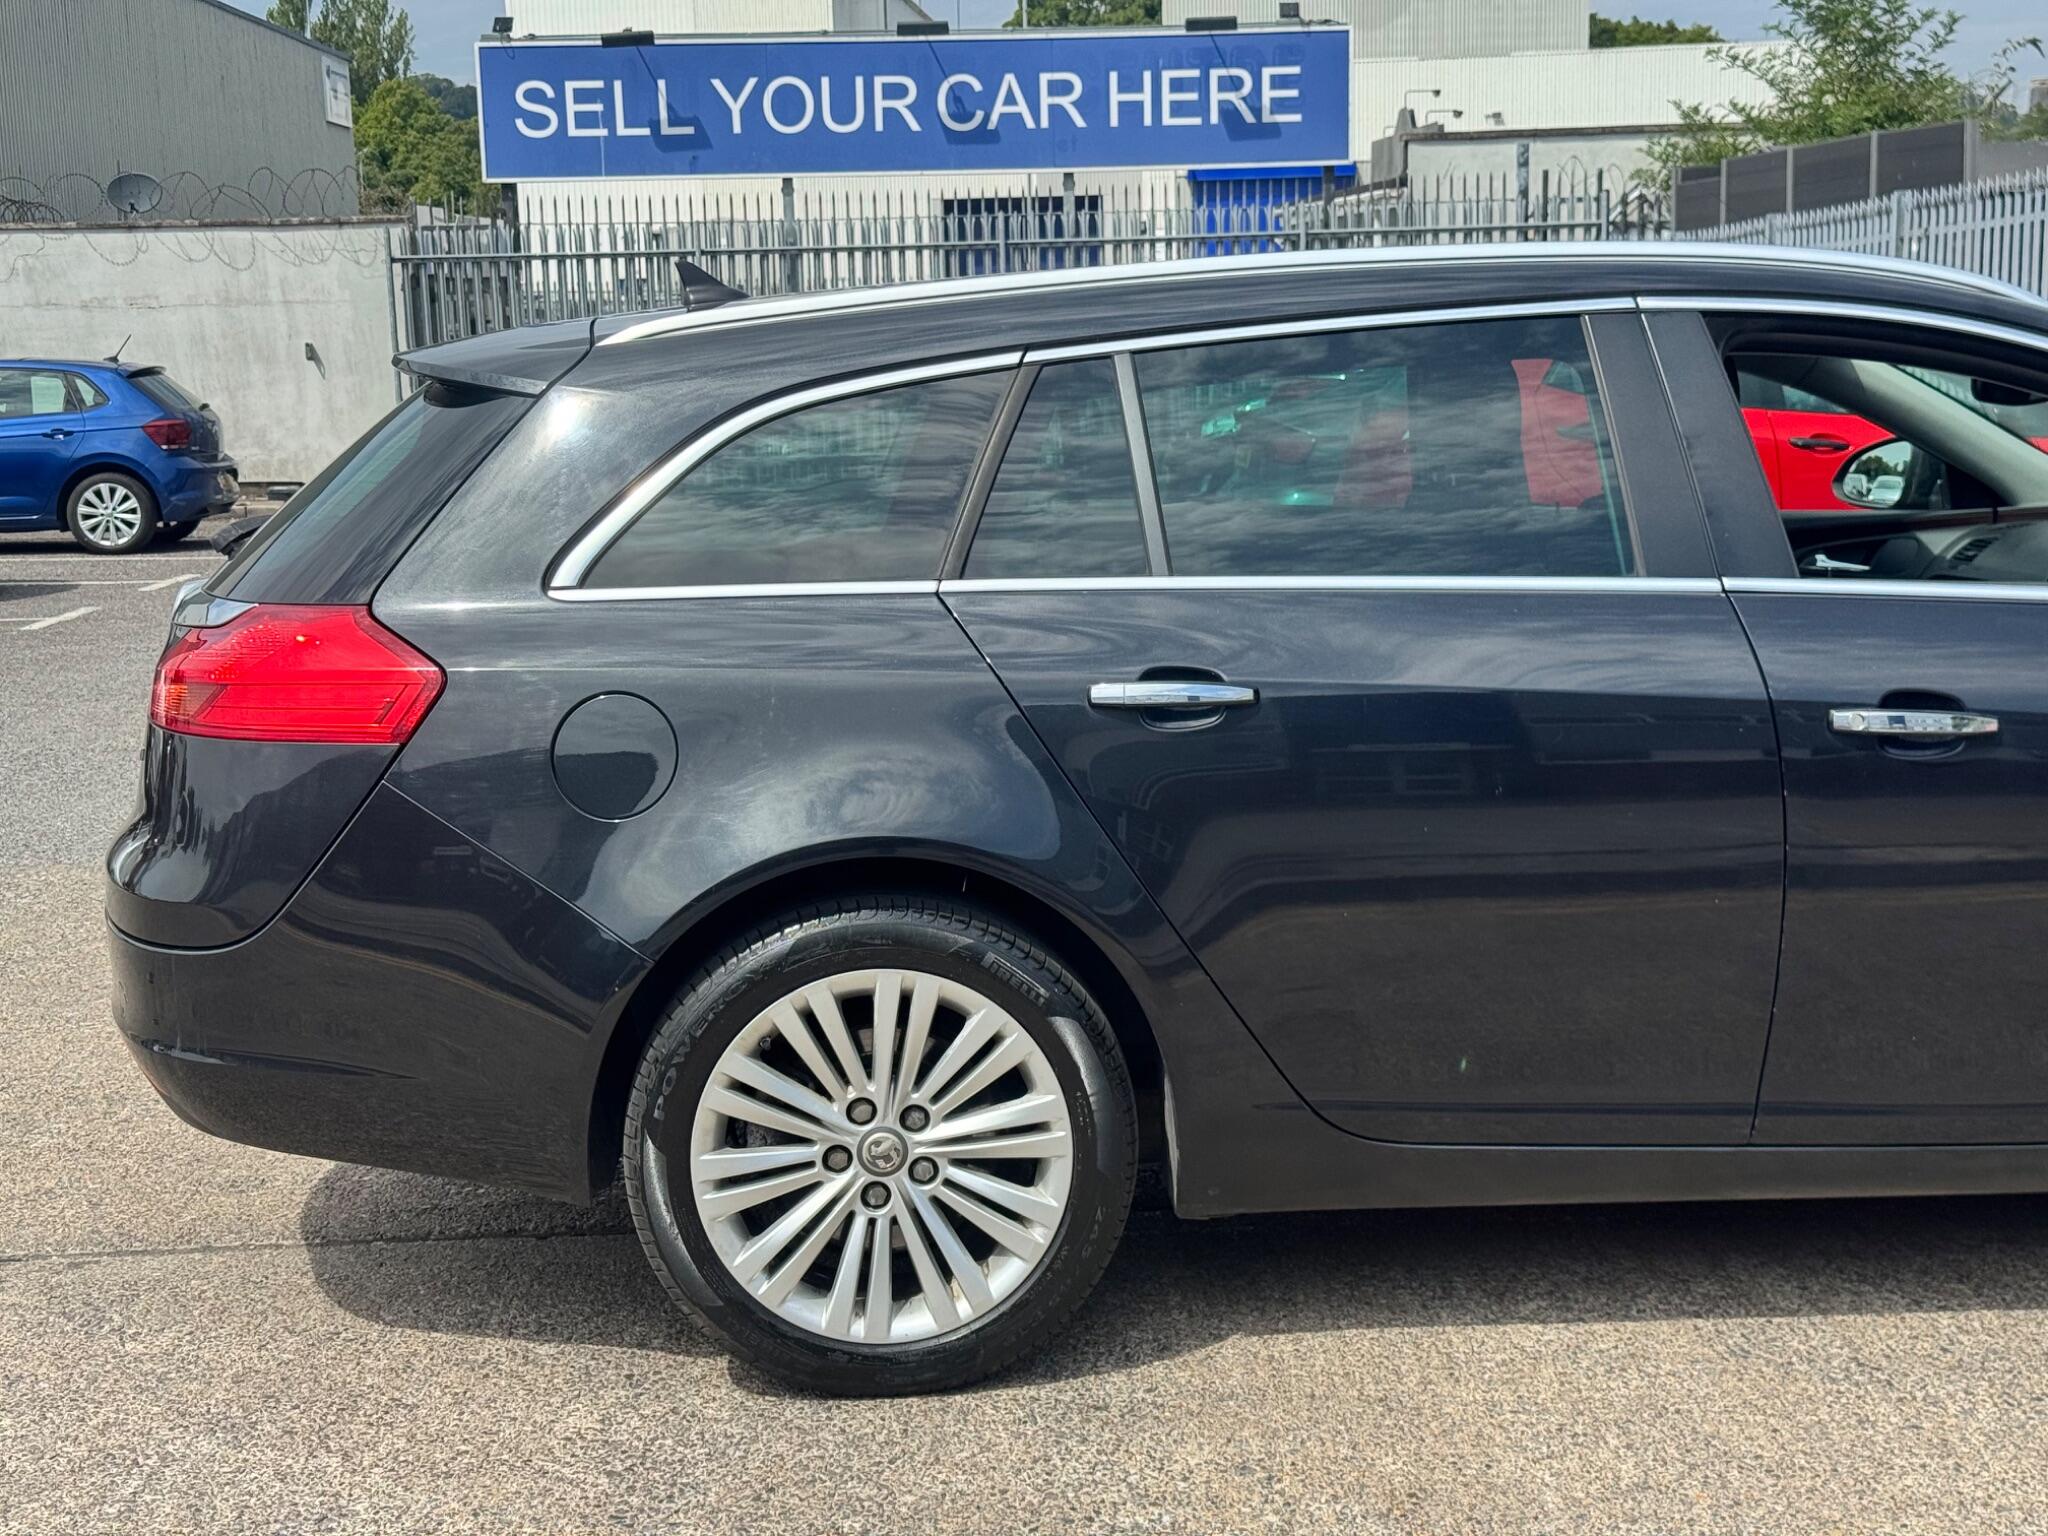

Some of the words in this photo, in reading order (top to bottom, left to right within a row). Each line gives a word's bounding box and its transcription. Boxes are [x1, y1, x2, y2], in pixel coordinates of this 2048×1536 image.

[514, 79, 696, 139] SELL
[709, 75, 923, 135] YOUR
[937, 72, 1088, 132] CAR
[1109, 65, 1303, 128] HERE
[980, 951, 1050, 1007] PIRELLI
